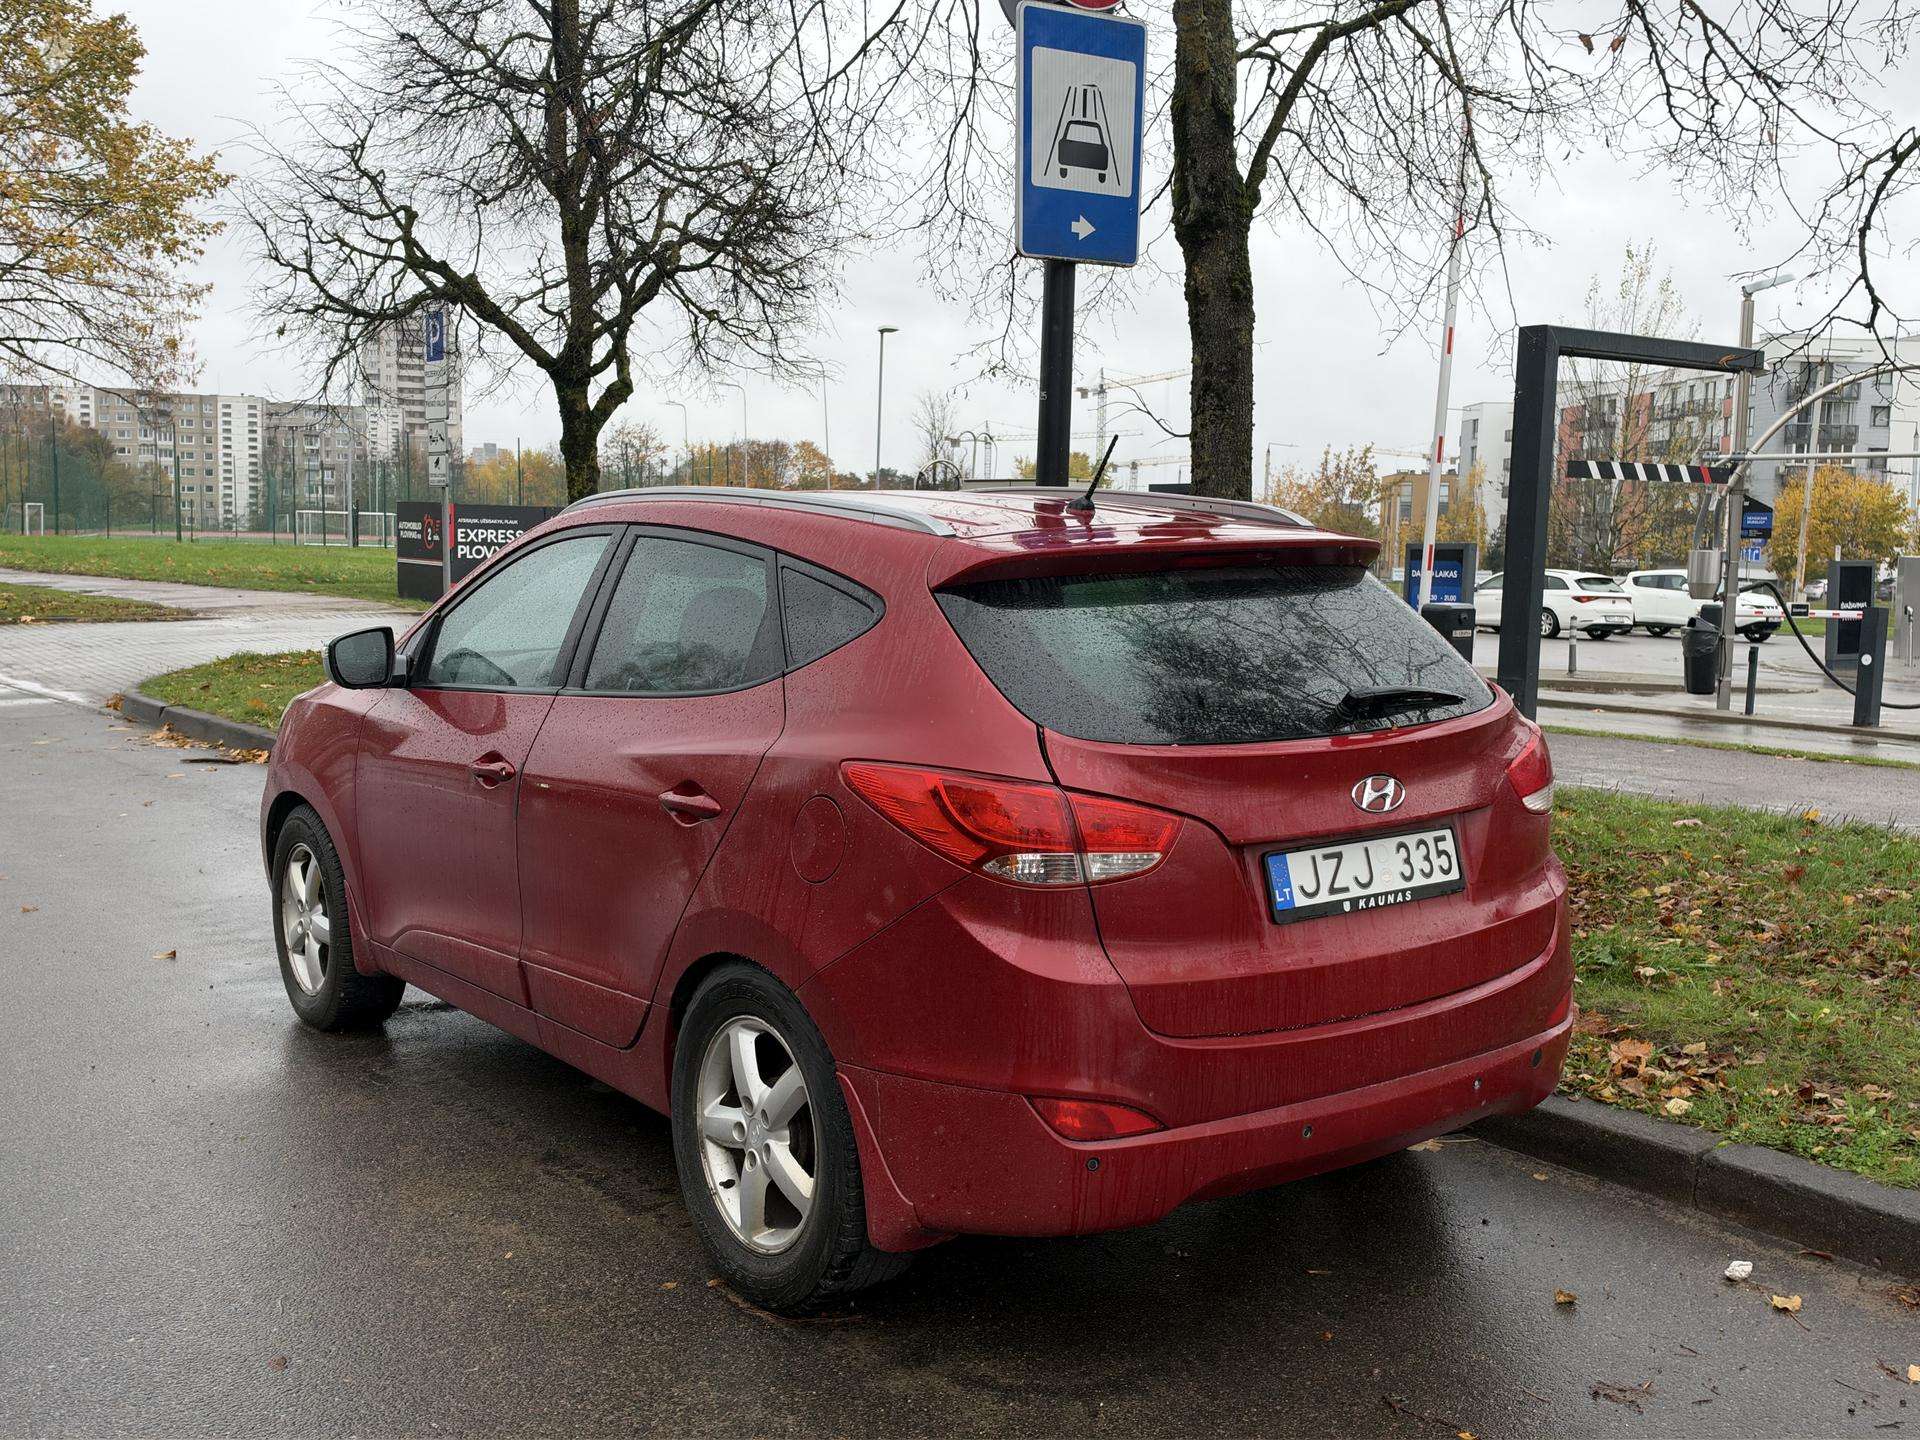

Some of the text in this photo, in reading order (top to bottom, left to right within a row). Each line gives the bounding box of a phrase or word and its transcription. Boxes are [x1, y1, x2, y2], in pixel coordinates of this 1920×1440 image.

[428, 528, 432, 541] 2
[1435, 570, 1458, 579] LAIKAS
[1298, 835, 1452, 899] JZJ 335
[1276, 887, 1291, 901] LT
[1358, 890, 1412, 910] KAUNAS
